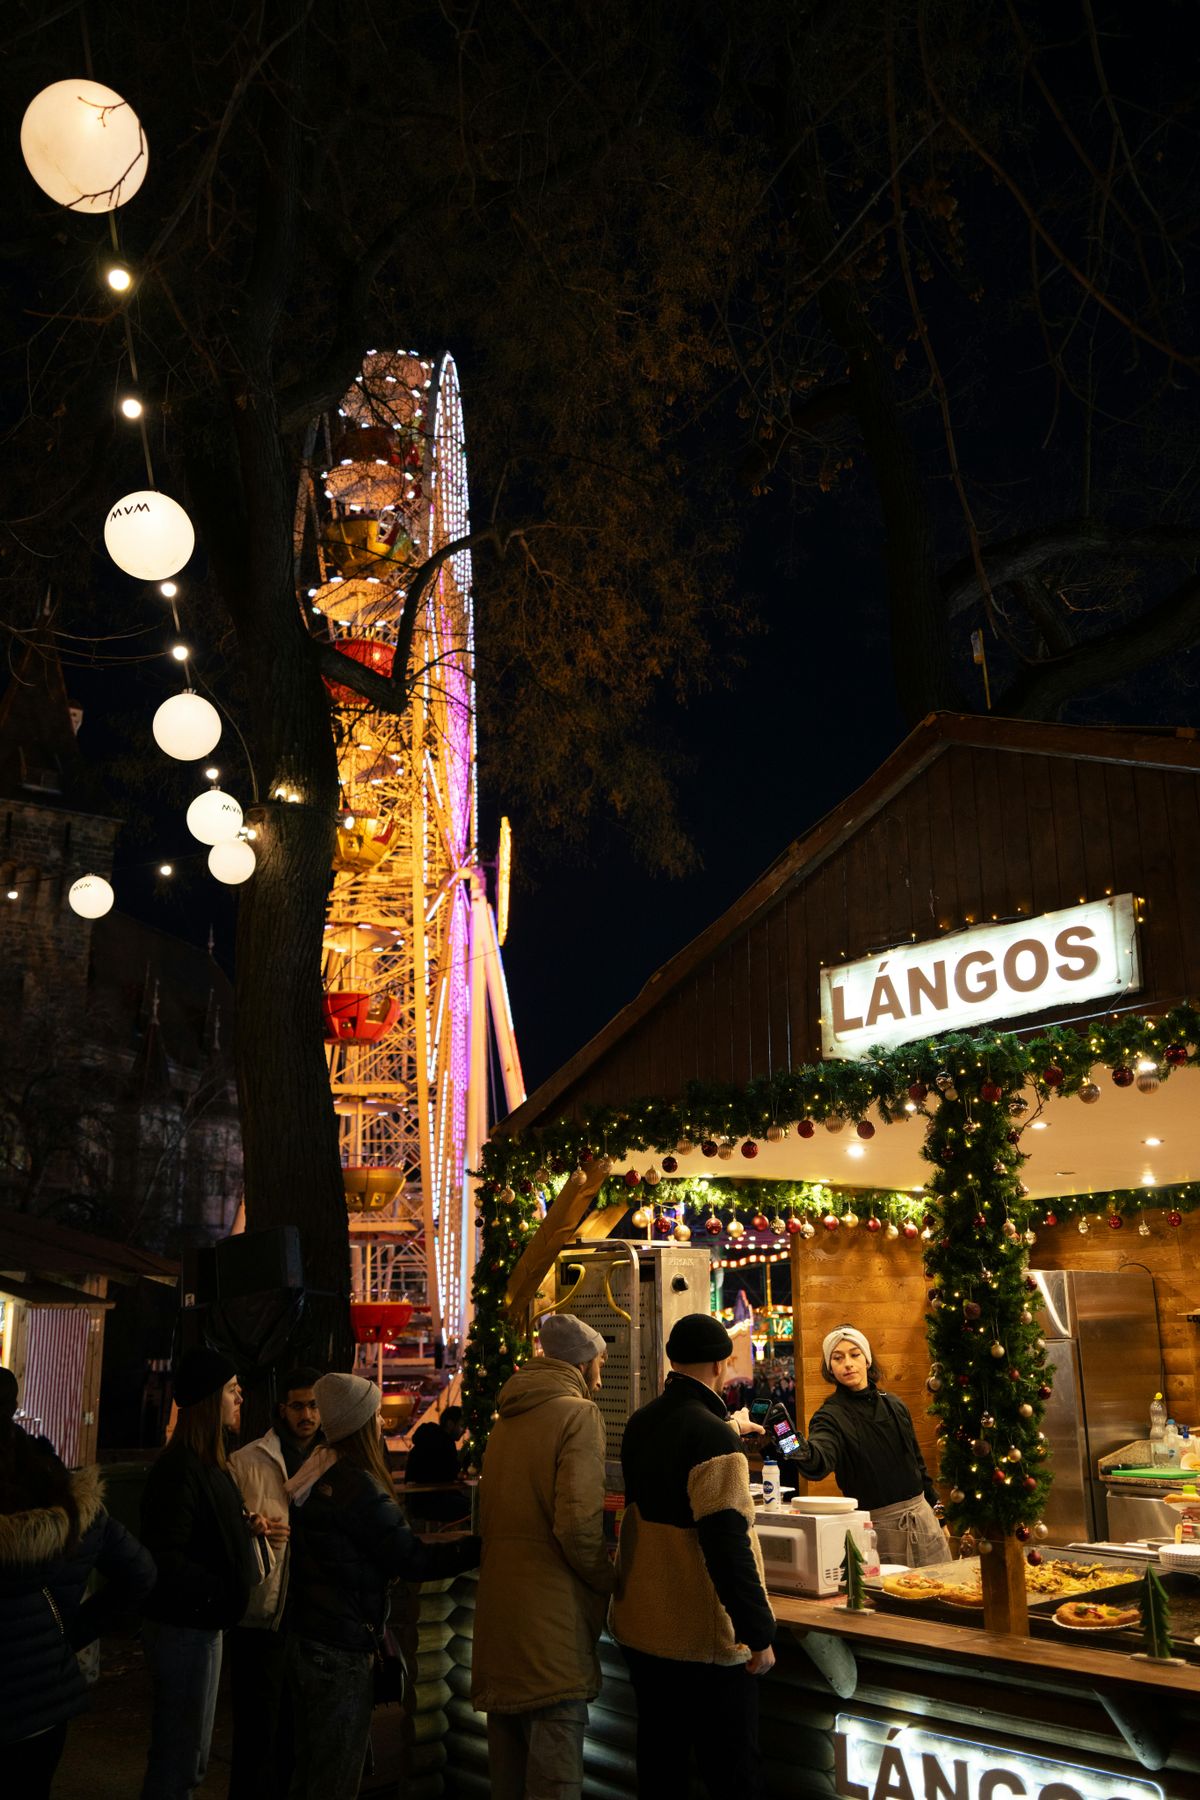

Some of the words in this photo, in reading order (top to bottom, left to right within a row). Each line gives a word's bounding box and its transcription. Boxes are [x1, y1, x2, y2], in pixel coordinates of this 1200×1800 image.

[110, 503, 150, 521] MVM
[832, 926, 1100, 1033] LÁNGOS
[833, 1723, 1135, 1800] LÁN
